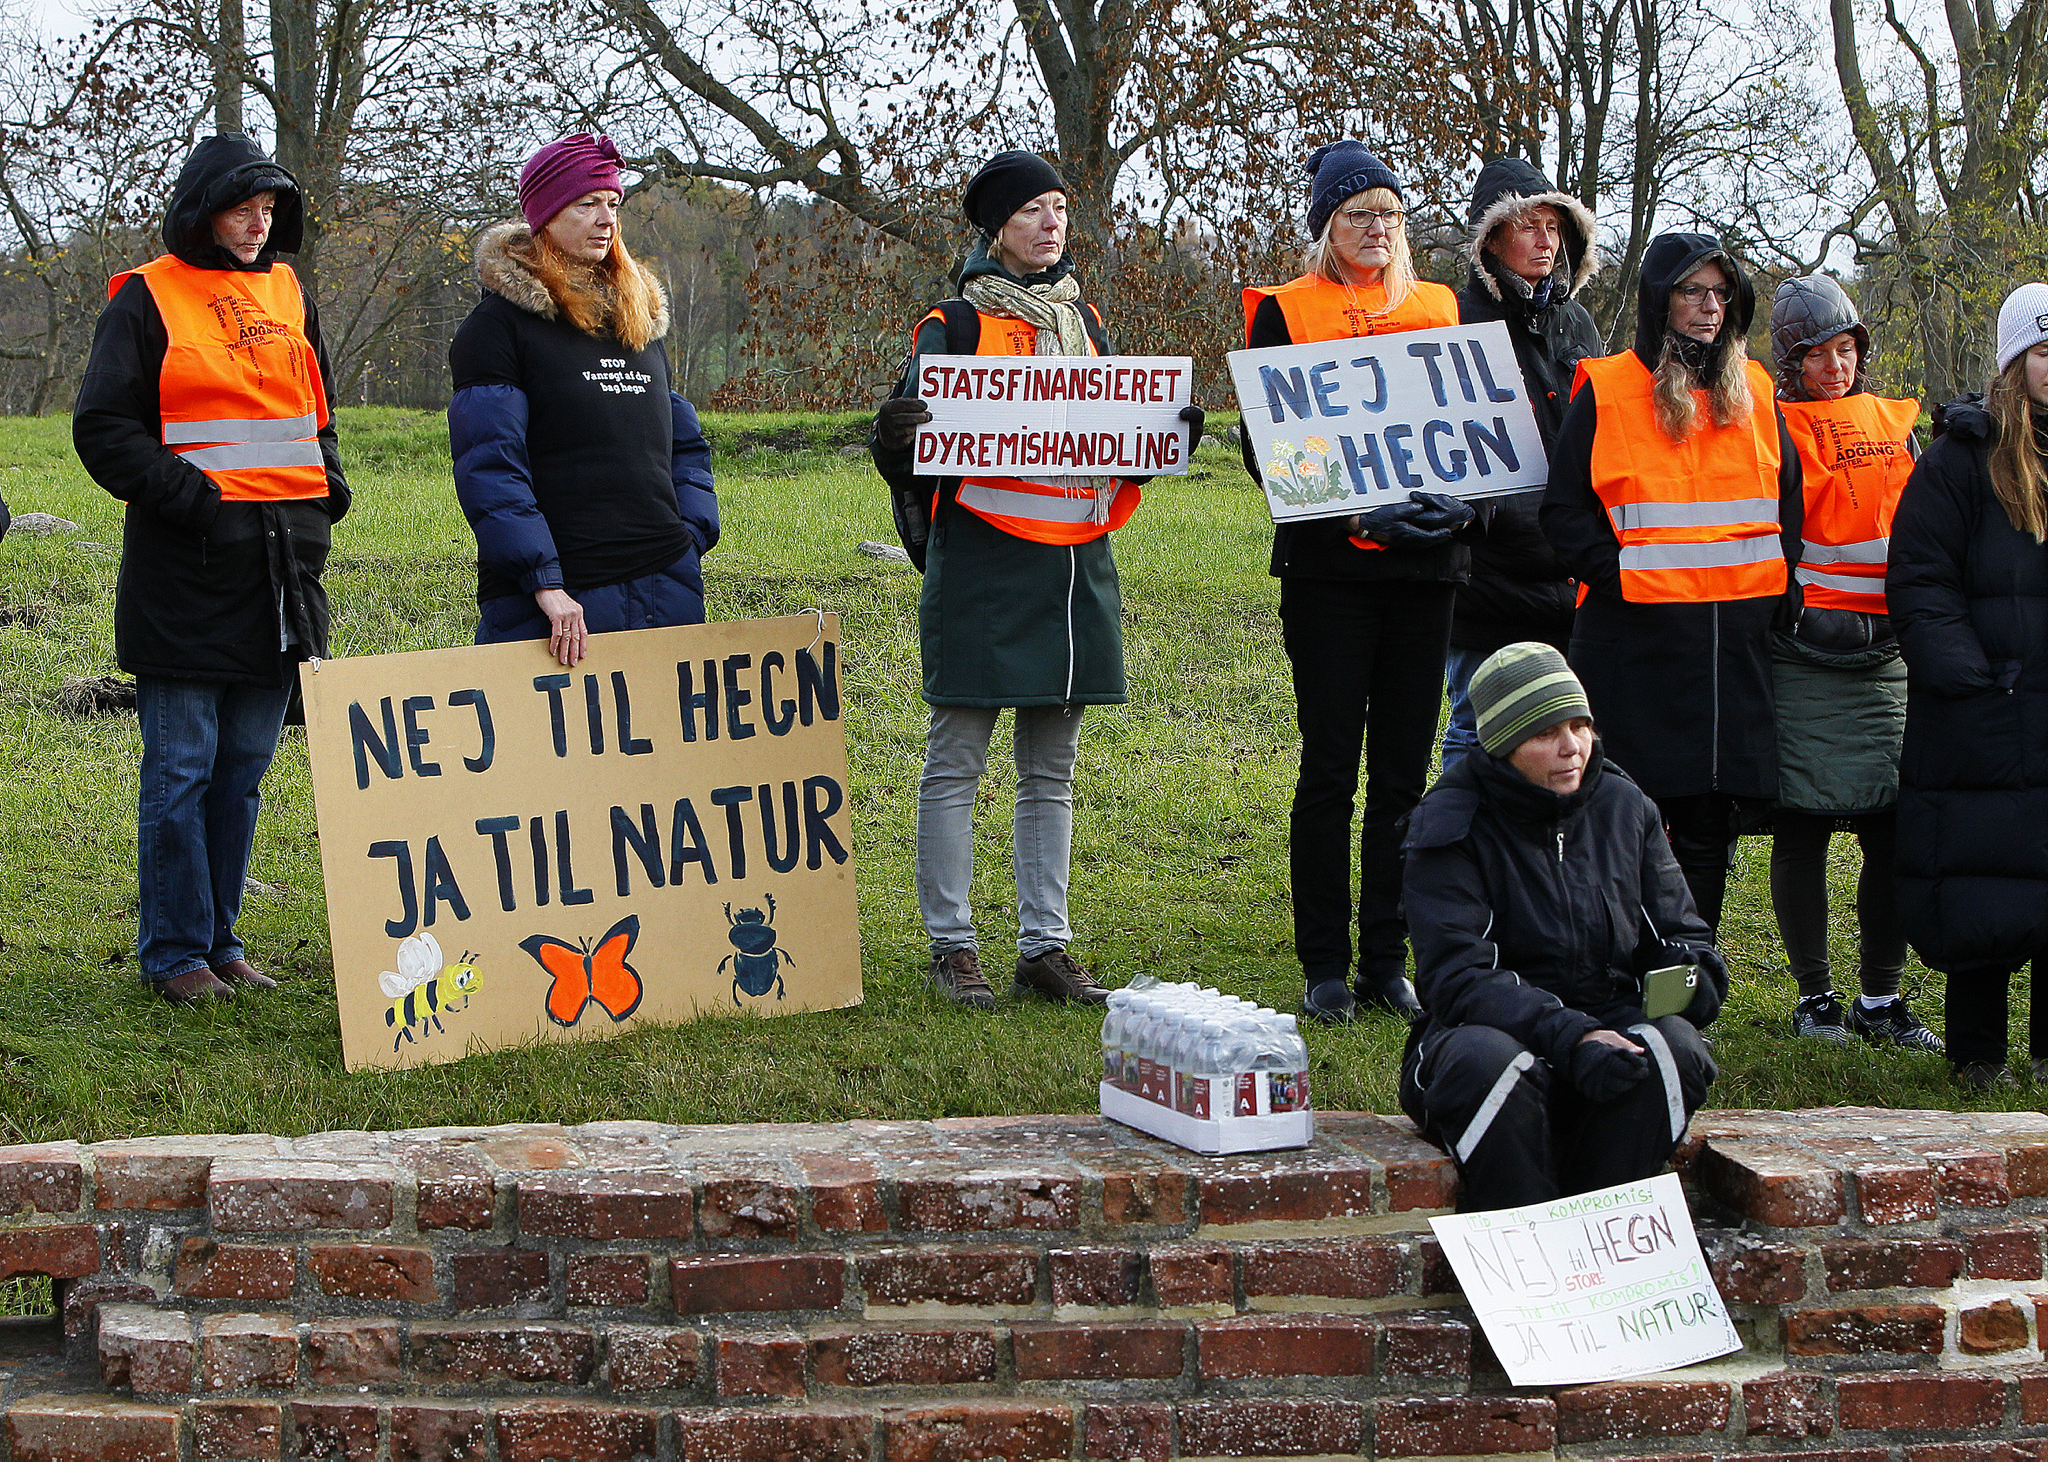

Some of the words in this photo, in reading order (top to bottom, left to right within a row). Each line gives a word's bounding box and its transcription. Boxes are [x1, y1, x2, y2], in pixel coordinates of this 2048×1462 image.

[207, 294, 233, 309] MOTION
[229, 299, 246, 329] HESTE
[214, 305, 227, 329] SUND
[1013, 336, 1022, 355] UND
[600, 358, 626, 368] STOP
[582, 371, 624, 382] Vanrøgt
[624, 371, 635, 380] af
[635, 371, 651, 384] dyr
[600, 382, 620, 394] bag
[619, 382, 646, 395] hegn
[922, 364, 1182, 404] STATSFiNANSiERET
[1259, 356, 1388, 423] NEJ
[1407, 340, 1517, 407] TIL
[1811, 418, 1833, 427] OTION
[917, 426, 1180, 469] DYREMiSHANDLiNG
[1828, 422, 1843, 451] HESTE
[1338, 417, 1521, 494] HEGN
[1836, 445, 1894, 462] ADGANG
[348, 688, 496, 790] NEJ
[534, 671, 653, 757] TIL
[677, 641, 840, 742] HEGN
[367, 835, 471, 938] JA
[475, 810, 594, 912] TIL
[610, 775, 848, 897] NATUR
[1195, 1103, 1203, 1115] A
[1240, 1097, 1250, 1110] A
[1463, 1221, 1560, 1298] NEJ
[1568, 1248, 1588, 1272] til
[1580, 1204, 1677, 1274] HEGN
[1503, 1322, 1551, 1366] JA
